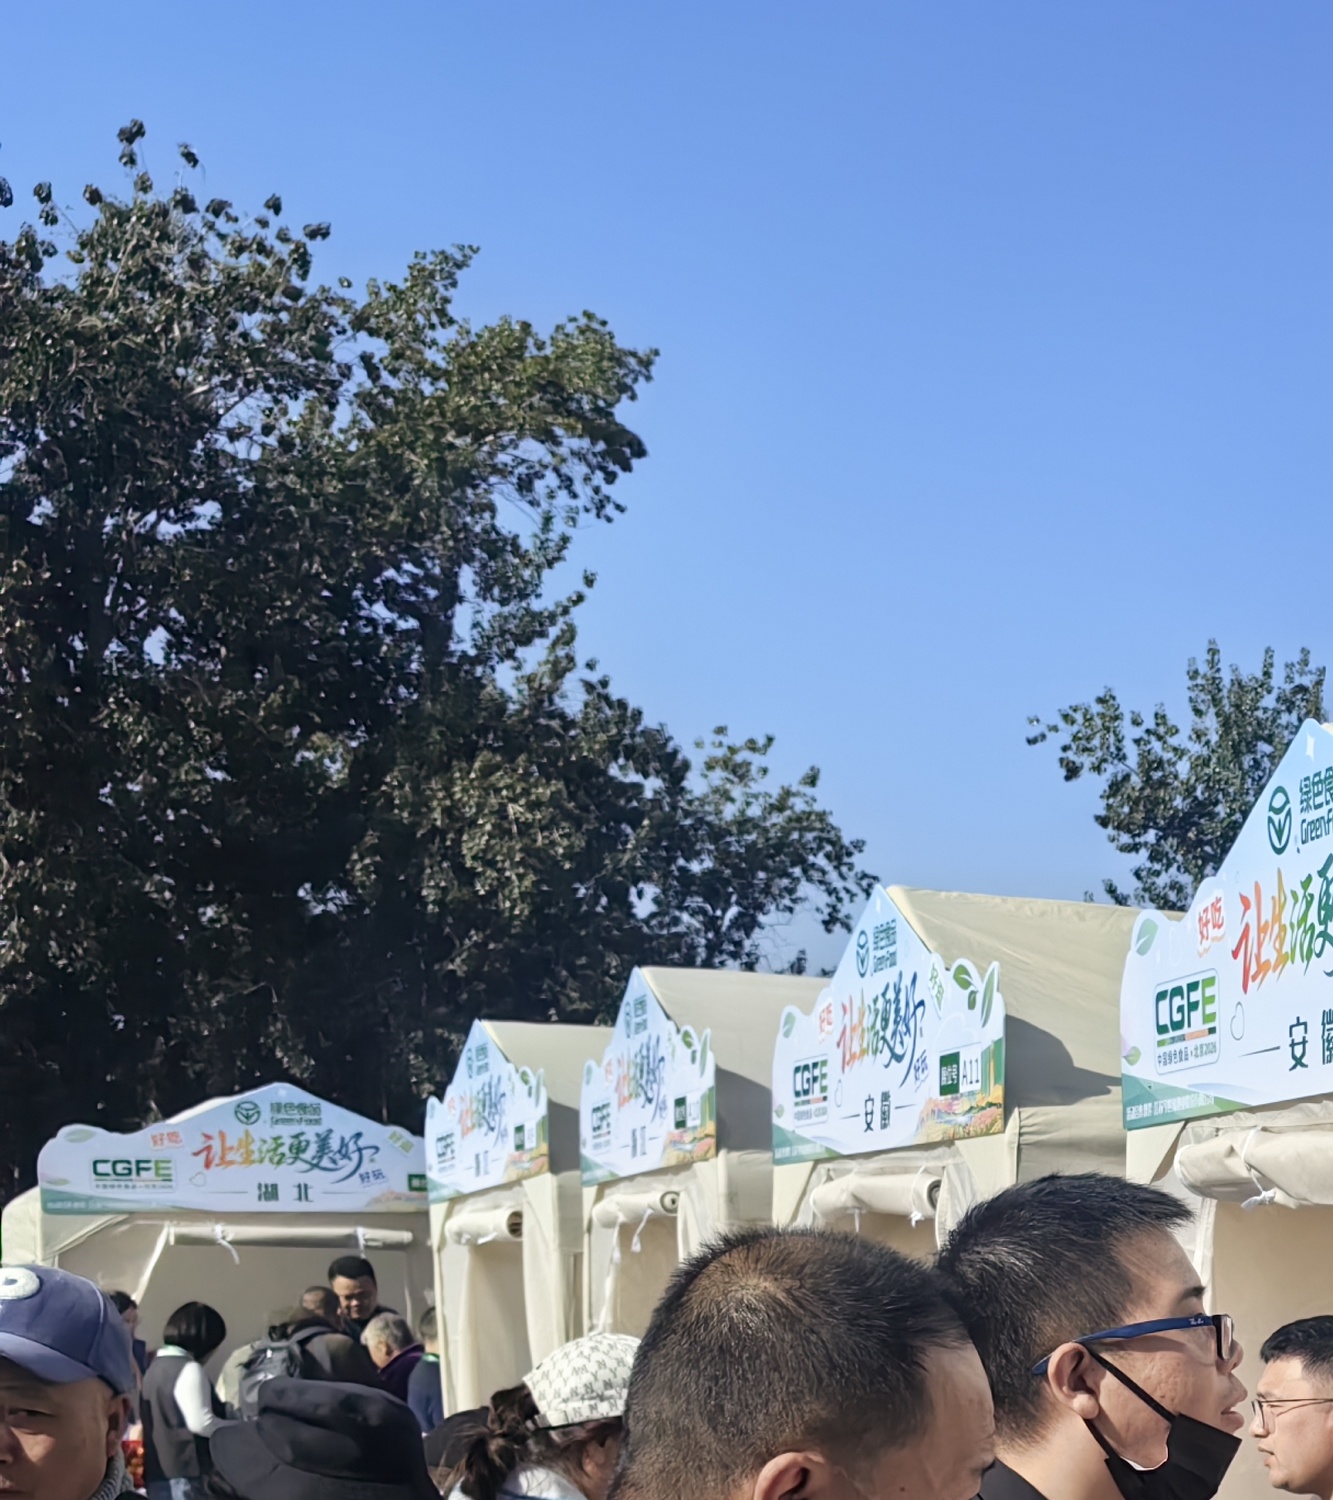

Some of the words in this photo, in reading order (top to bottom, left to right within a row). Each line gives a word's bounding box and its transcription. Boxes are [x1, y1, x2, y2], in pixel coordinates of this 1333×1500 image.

[1197, 895, 1225, 943] 好吃
[1155, 976, 1217, 1035] CGFE
[793, 1059, 828, 1098] CGFE
[961, 1058, 980, 1086] A11
[92, 1159, 173, 1177] CGFE
[192, 1128, 380, 1184] 让生活更美好
[257, 1182, 314, 1203] 湖北
